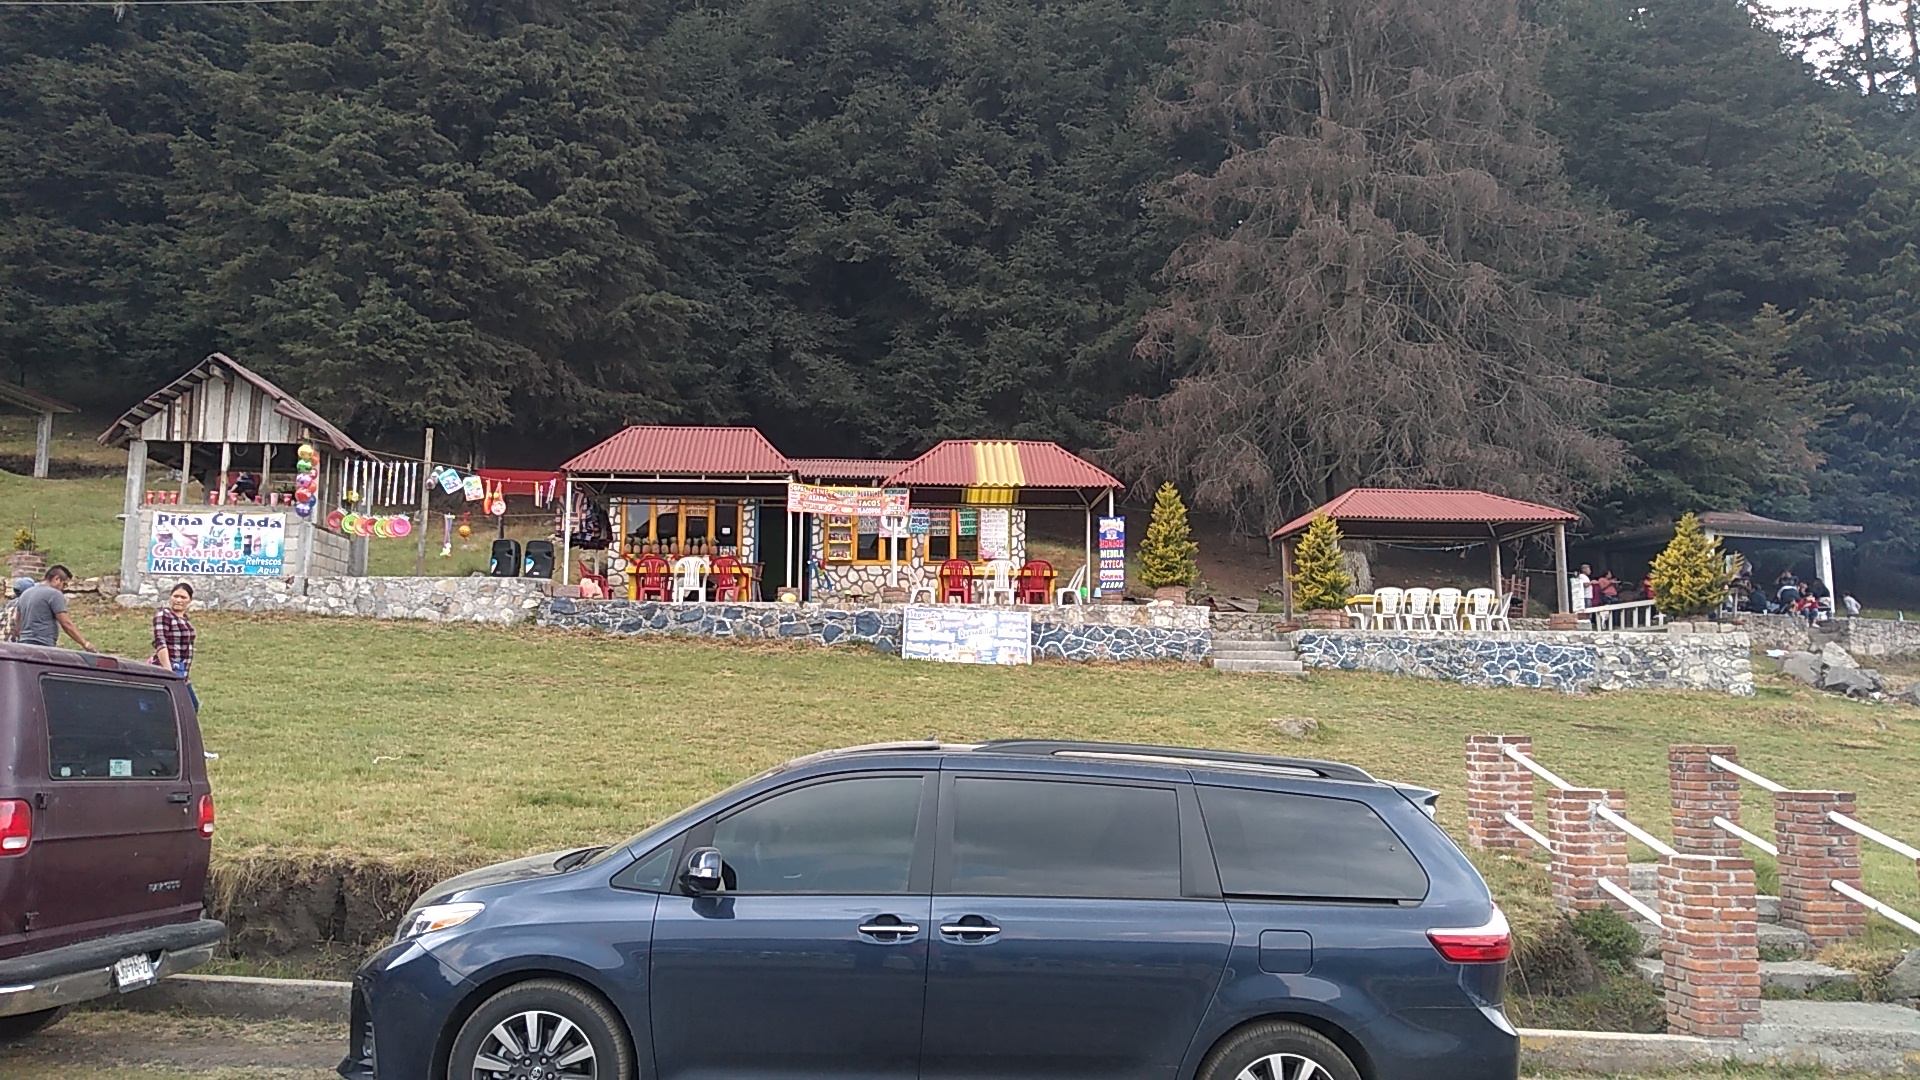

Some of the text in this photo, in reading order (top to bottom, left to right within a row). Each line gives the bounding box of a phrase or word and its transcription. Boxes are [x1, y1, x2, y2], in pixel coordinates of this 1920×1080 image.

[157, 511, 282, 528] Piña Colada
[153, 544, 241, 559] Cantaritos
[245, 556, 282, 566] Refrescos
[1100, 560, 1124, 568] AZTECA
[152, 559, 245, 574] Micheladas
[257, 566, 280, 575] Agua
[959, 628, 997, 638] Quesadillas
